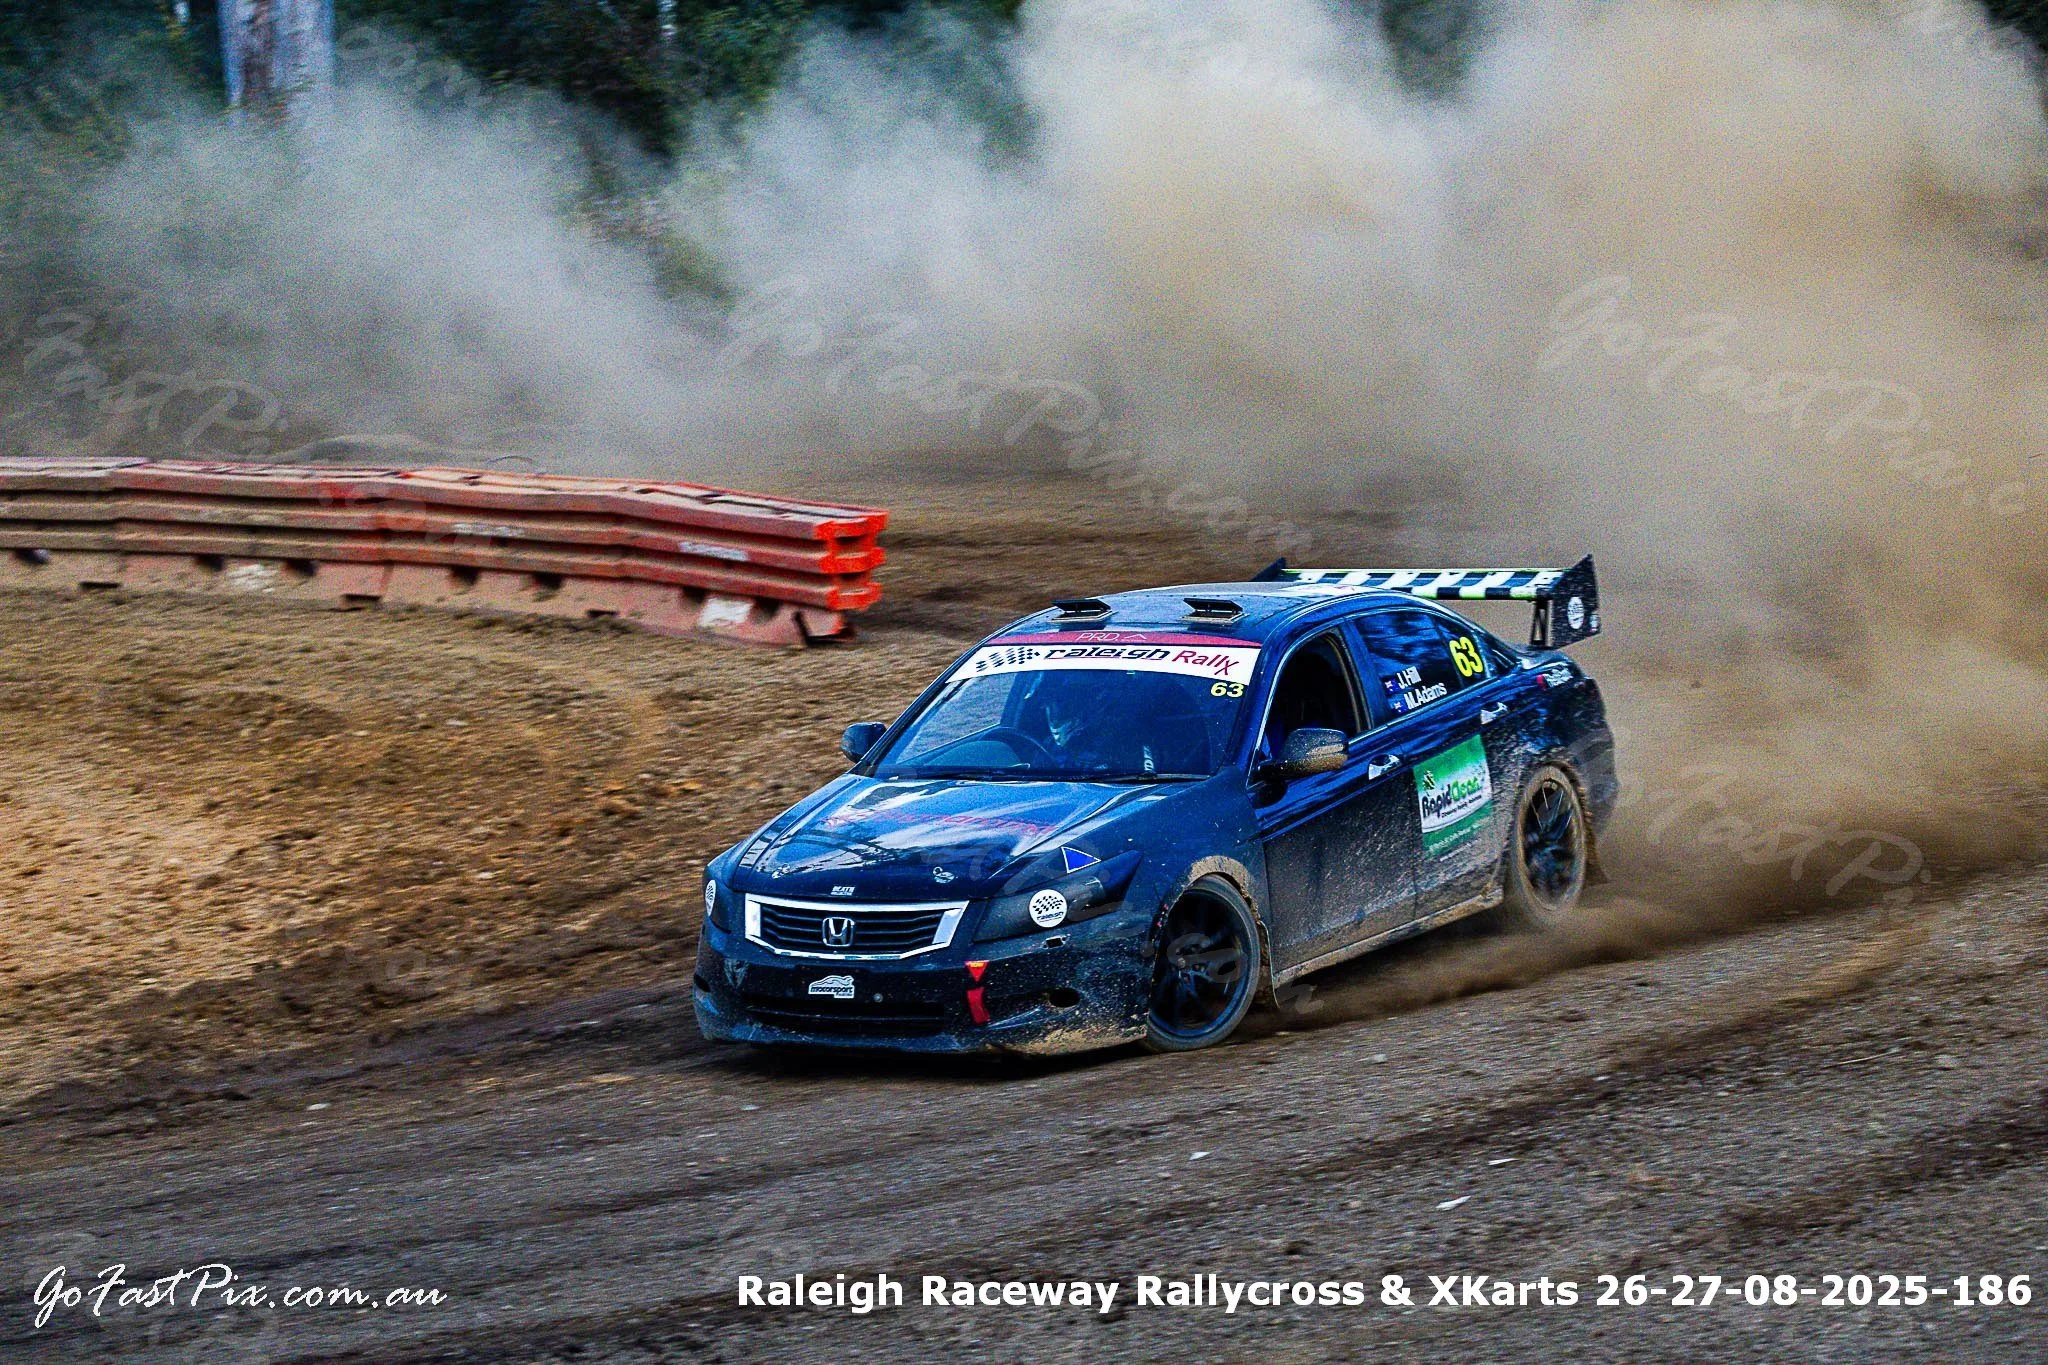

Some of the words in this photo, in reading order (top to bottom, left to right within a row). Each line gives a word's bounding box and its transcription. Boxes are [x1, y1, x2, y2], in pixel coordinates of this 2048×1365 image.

[1044, 646, 1171, 660] raleigh
[1449, 636, 1484, 677] 63
[1210, 682, 1245, 698] 63
[810, 986, 853, 996] motorsport
